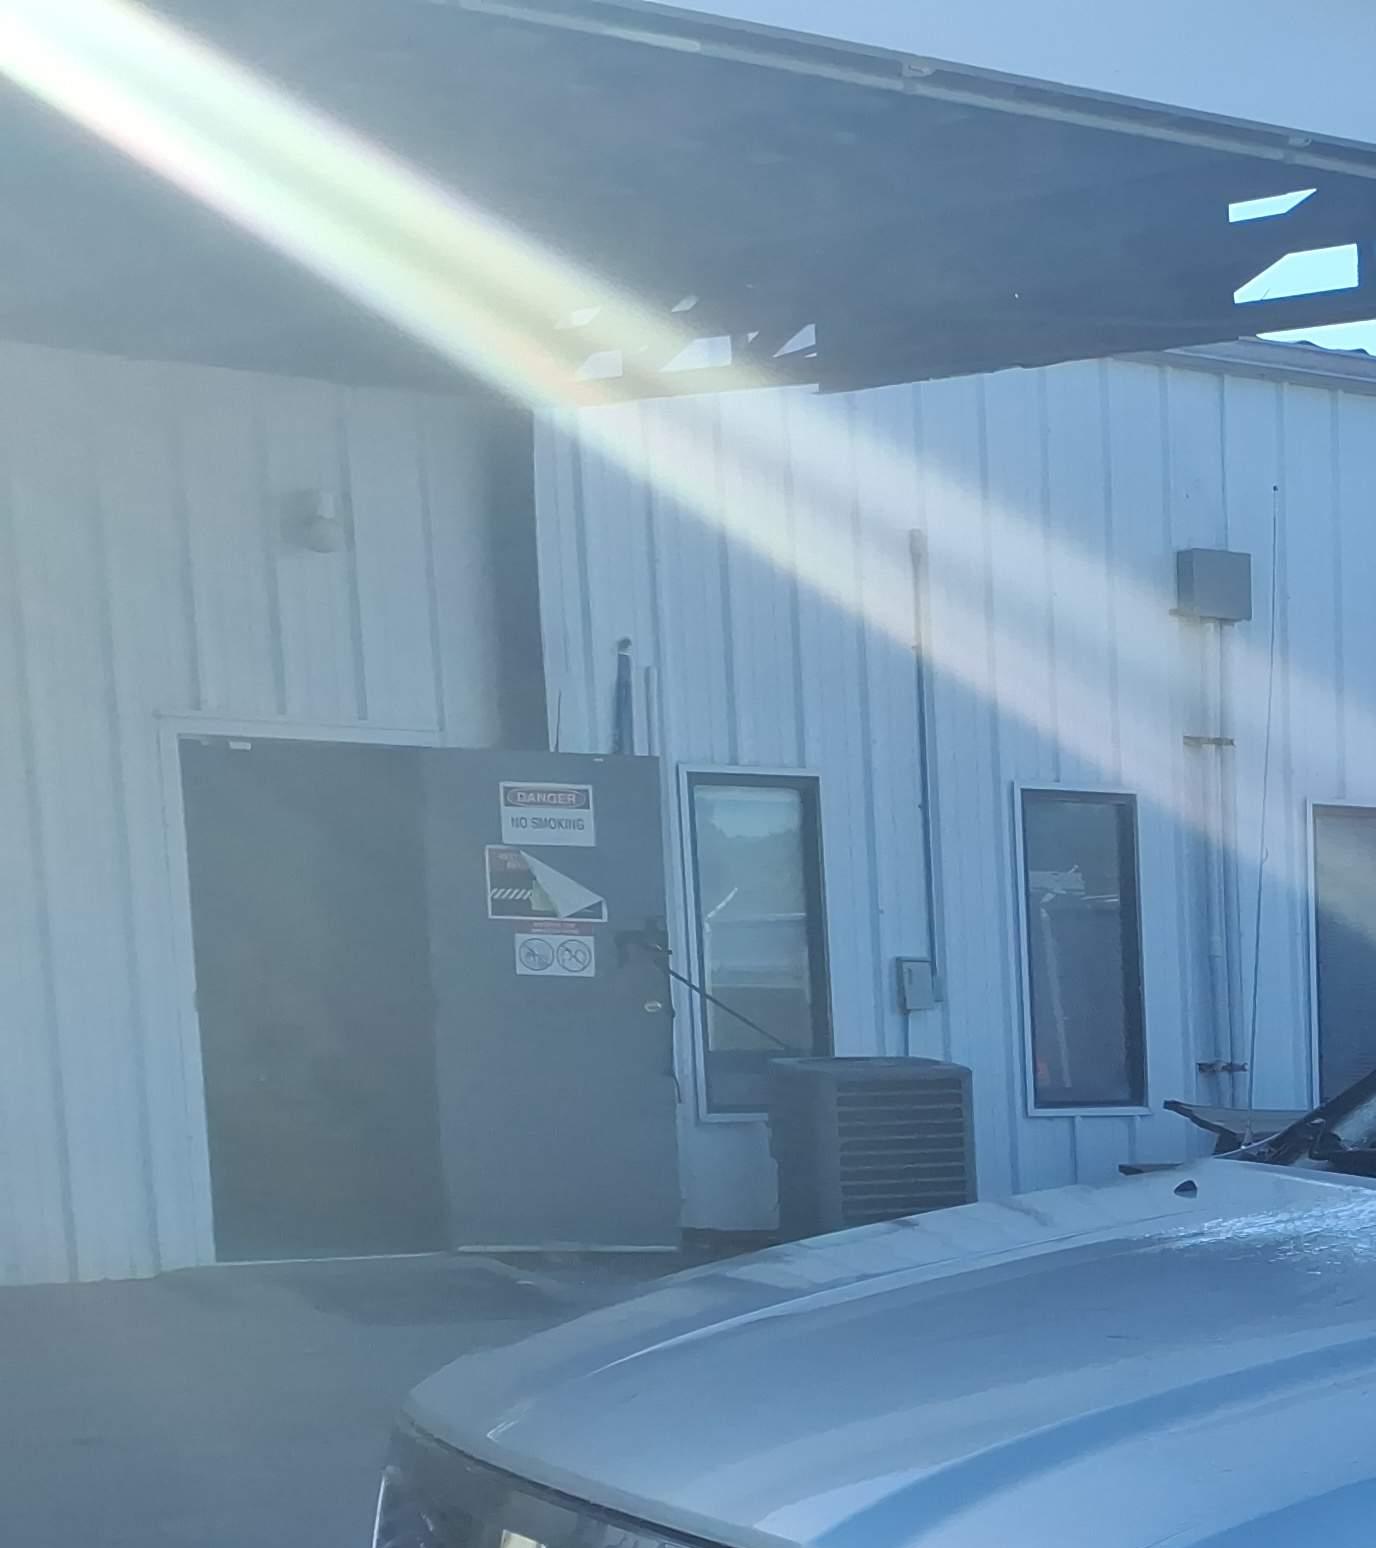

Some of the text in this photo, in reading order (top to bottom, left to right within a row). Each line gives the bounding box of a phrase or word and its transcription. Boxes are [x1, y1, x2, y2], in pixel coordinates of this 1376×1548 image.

[516, 791, 577, 804] DANGER
[511, 816, 585, 831] NO SMOKING
